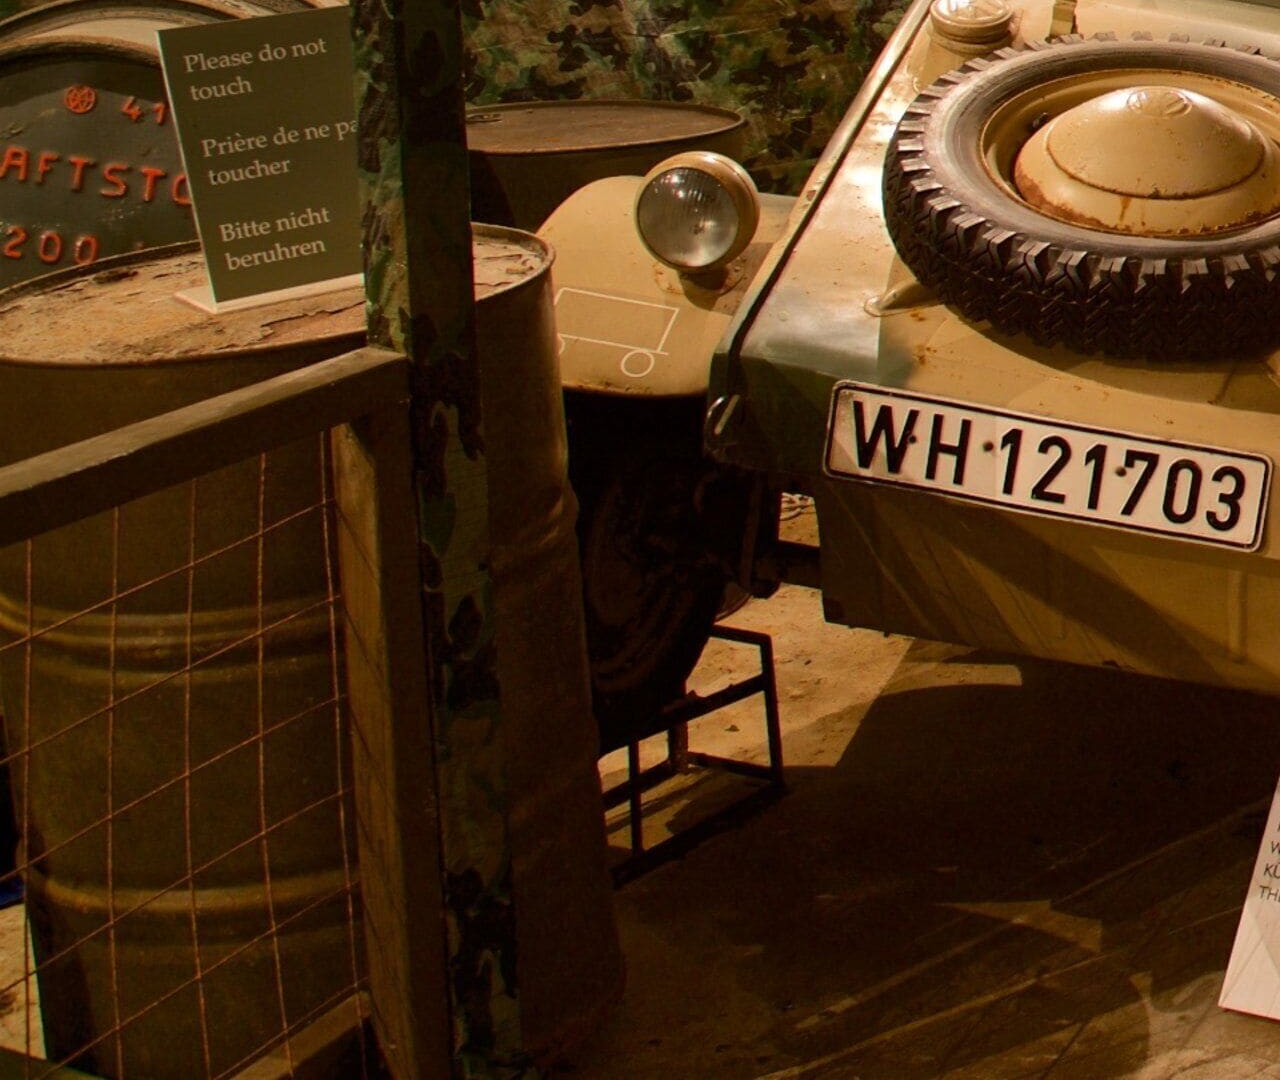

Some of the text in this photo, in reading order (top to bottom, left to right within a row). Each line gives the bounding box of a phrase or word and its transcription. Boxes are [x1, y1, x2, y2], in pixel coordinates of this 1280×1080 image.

[184, 38, 327, 72] Please do not
[191, 76, 252, 101] touch
[202, 133, 267, 158] Prière
[273, 126, 299, 146] de
[304, 124, 329, 140] ne
[208, 159, 290, 186] toucher
[220, 207, 330, 242] Bitte nicht
[225, 239, 326, 271] beruhren
[1000, 428, 1246, 532] 121703
